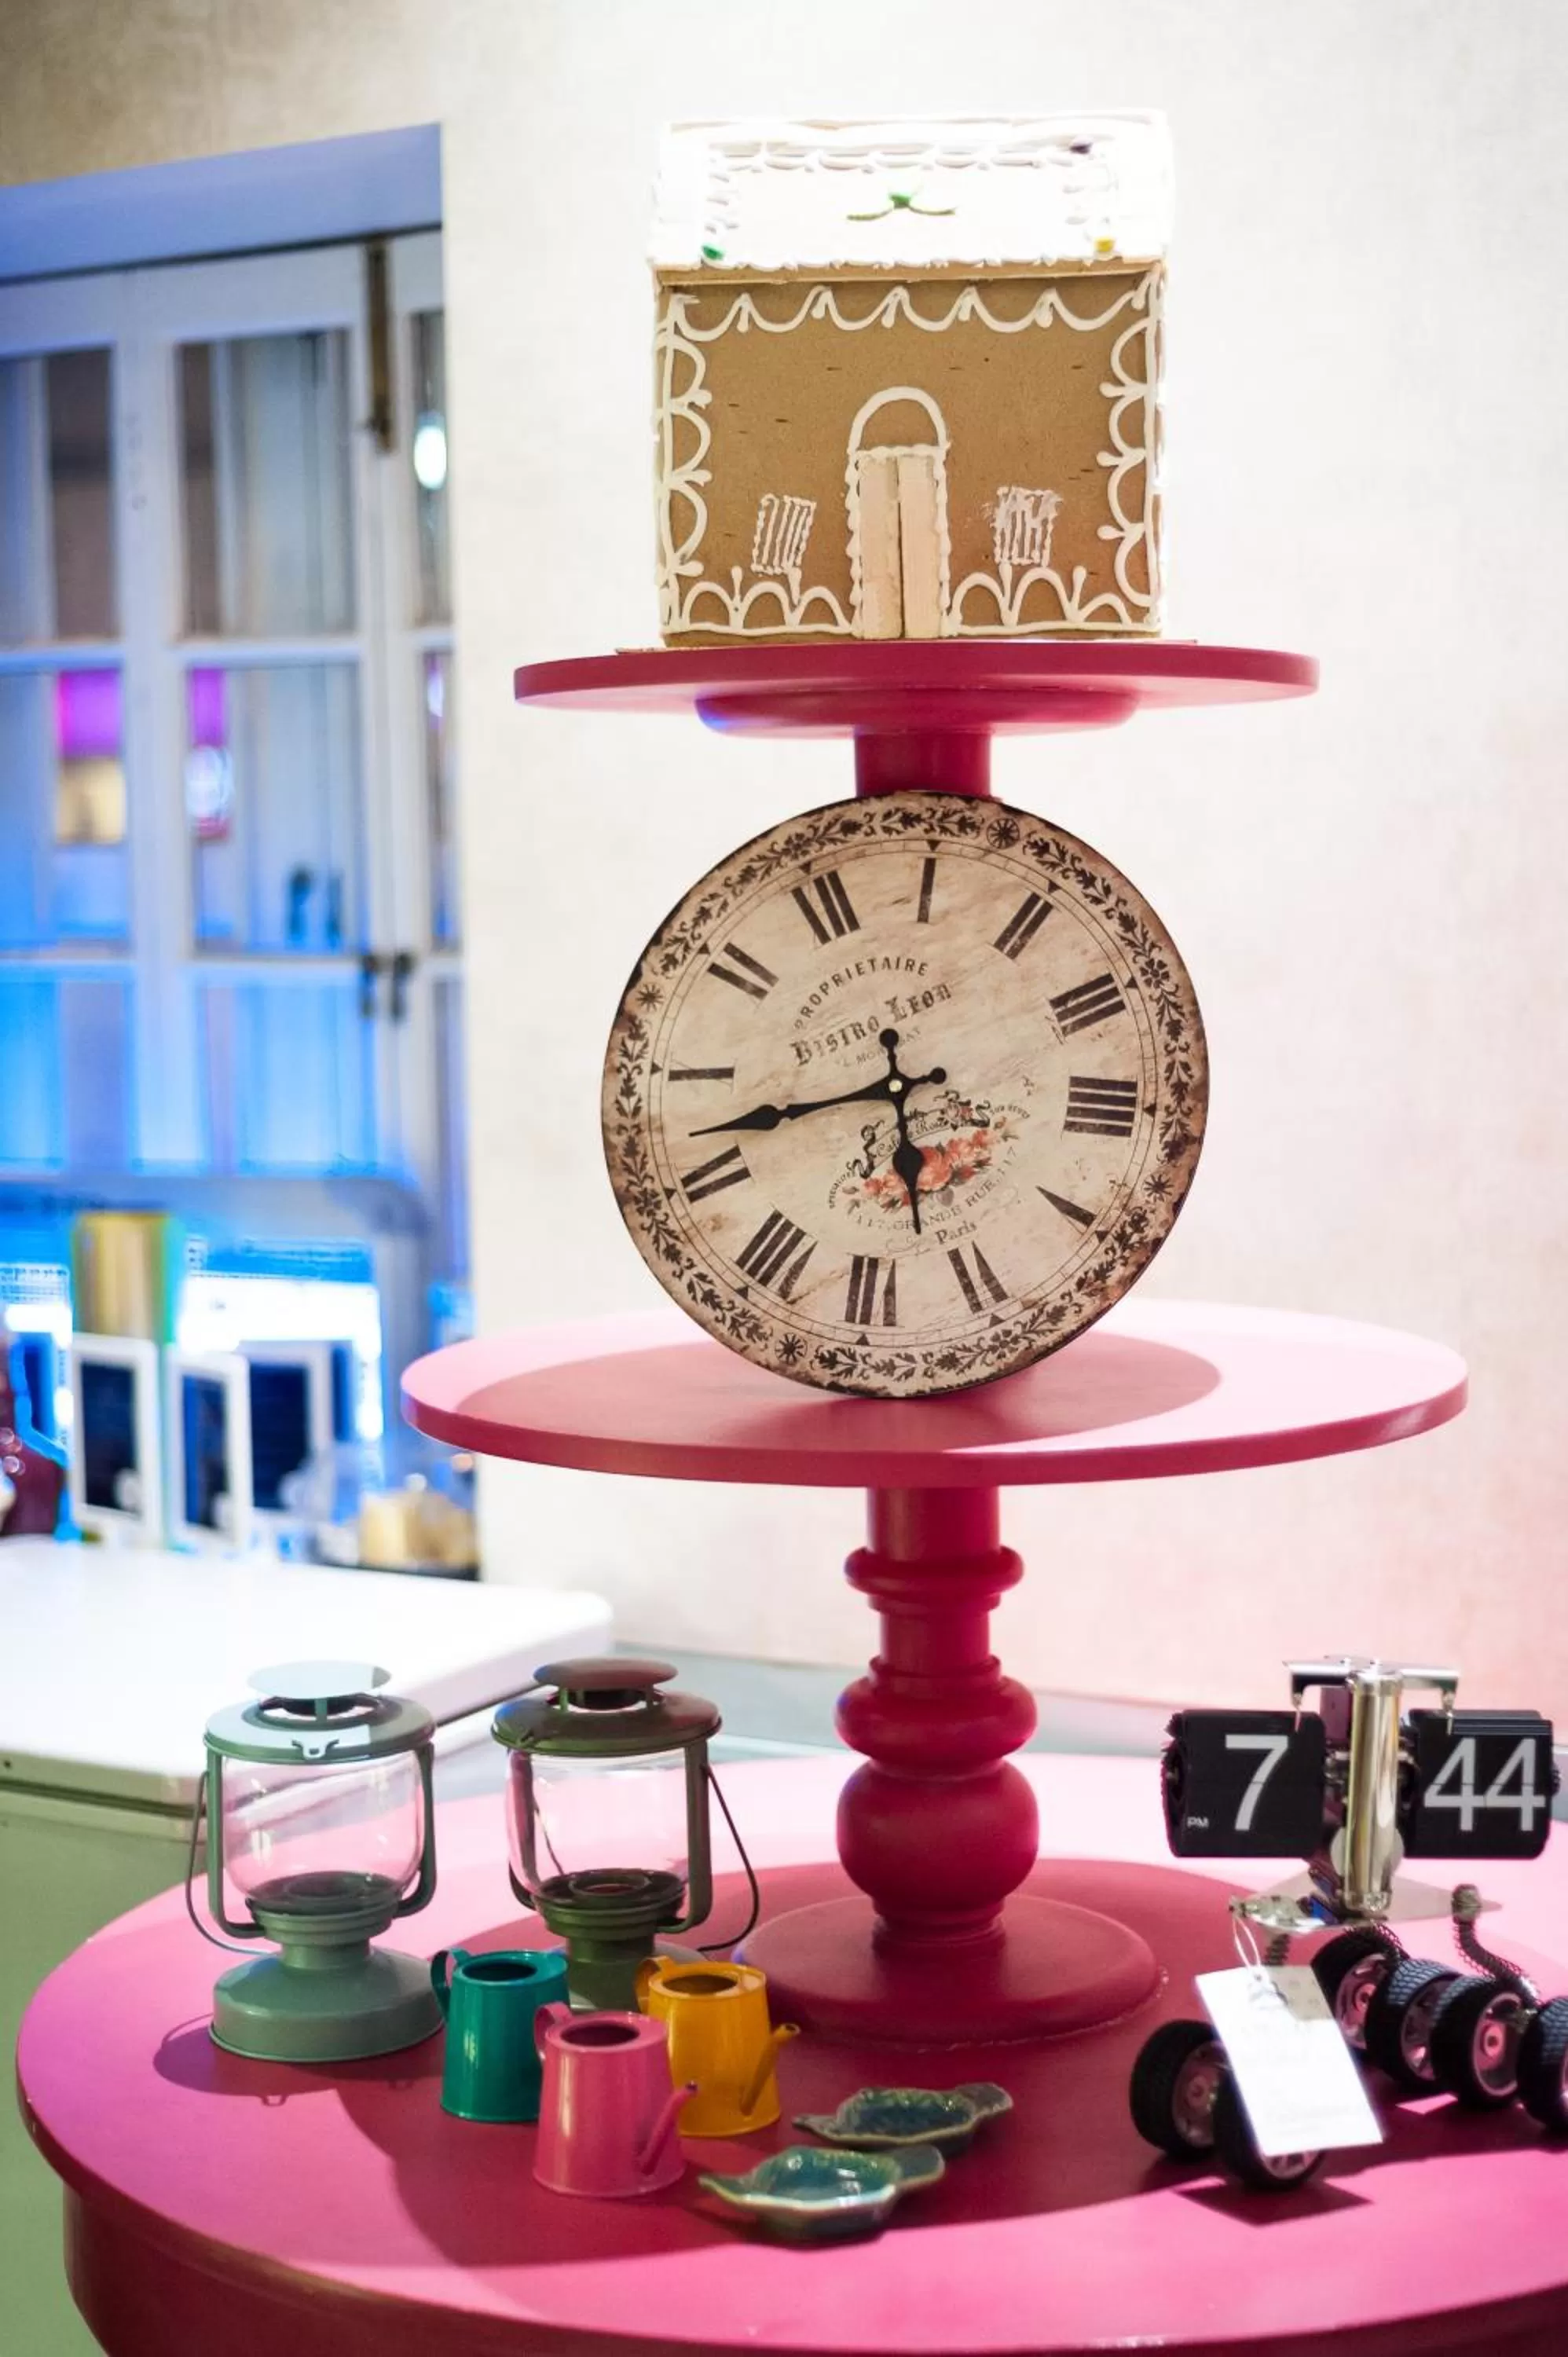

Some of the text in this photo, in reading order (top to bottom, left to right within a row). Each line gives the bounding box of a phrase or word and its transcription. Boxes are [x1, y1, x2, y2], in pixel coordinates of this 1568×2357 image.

[916, 856, 938, 923] I
[992, 890, 1055, 960] II
[793, 956, 929, 1031] PROPRIETAIRE
[1046, 973, 1128, 1039] III
[936, 1220, 977, 1244] Paris
[1225, 1734, 1289, 1831] 7
[1423, 1736, 1547, 1832] 44
[1187, 1816, 1209, 1828] PM
